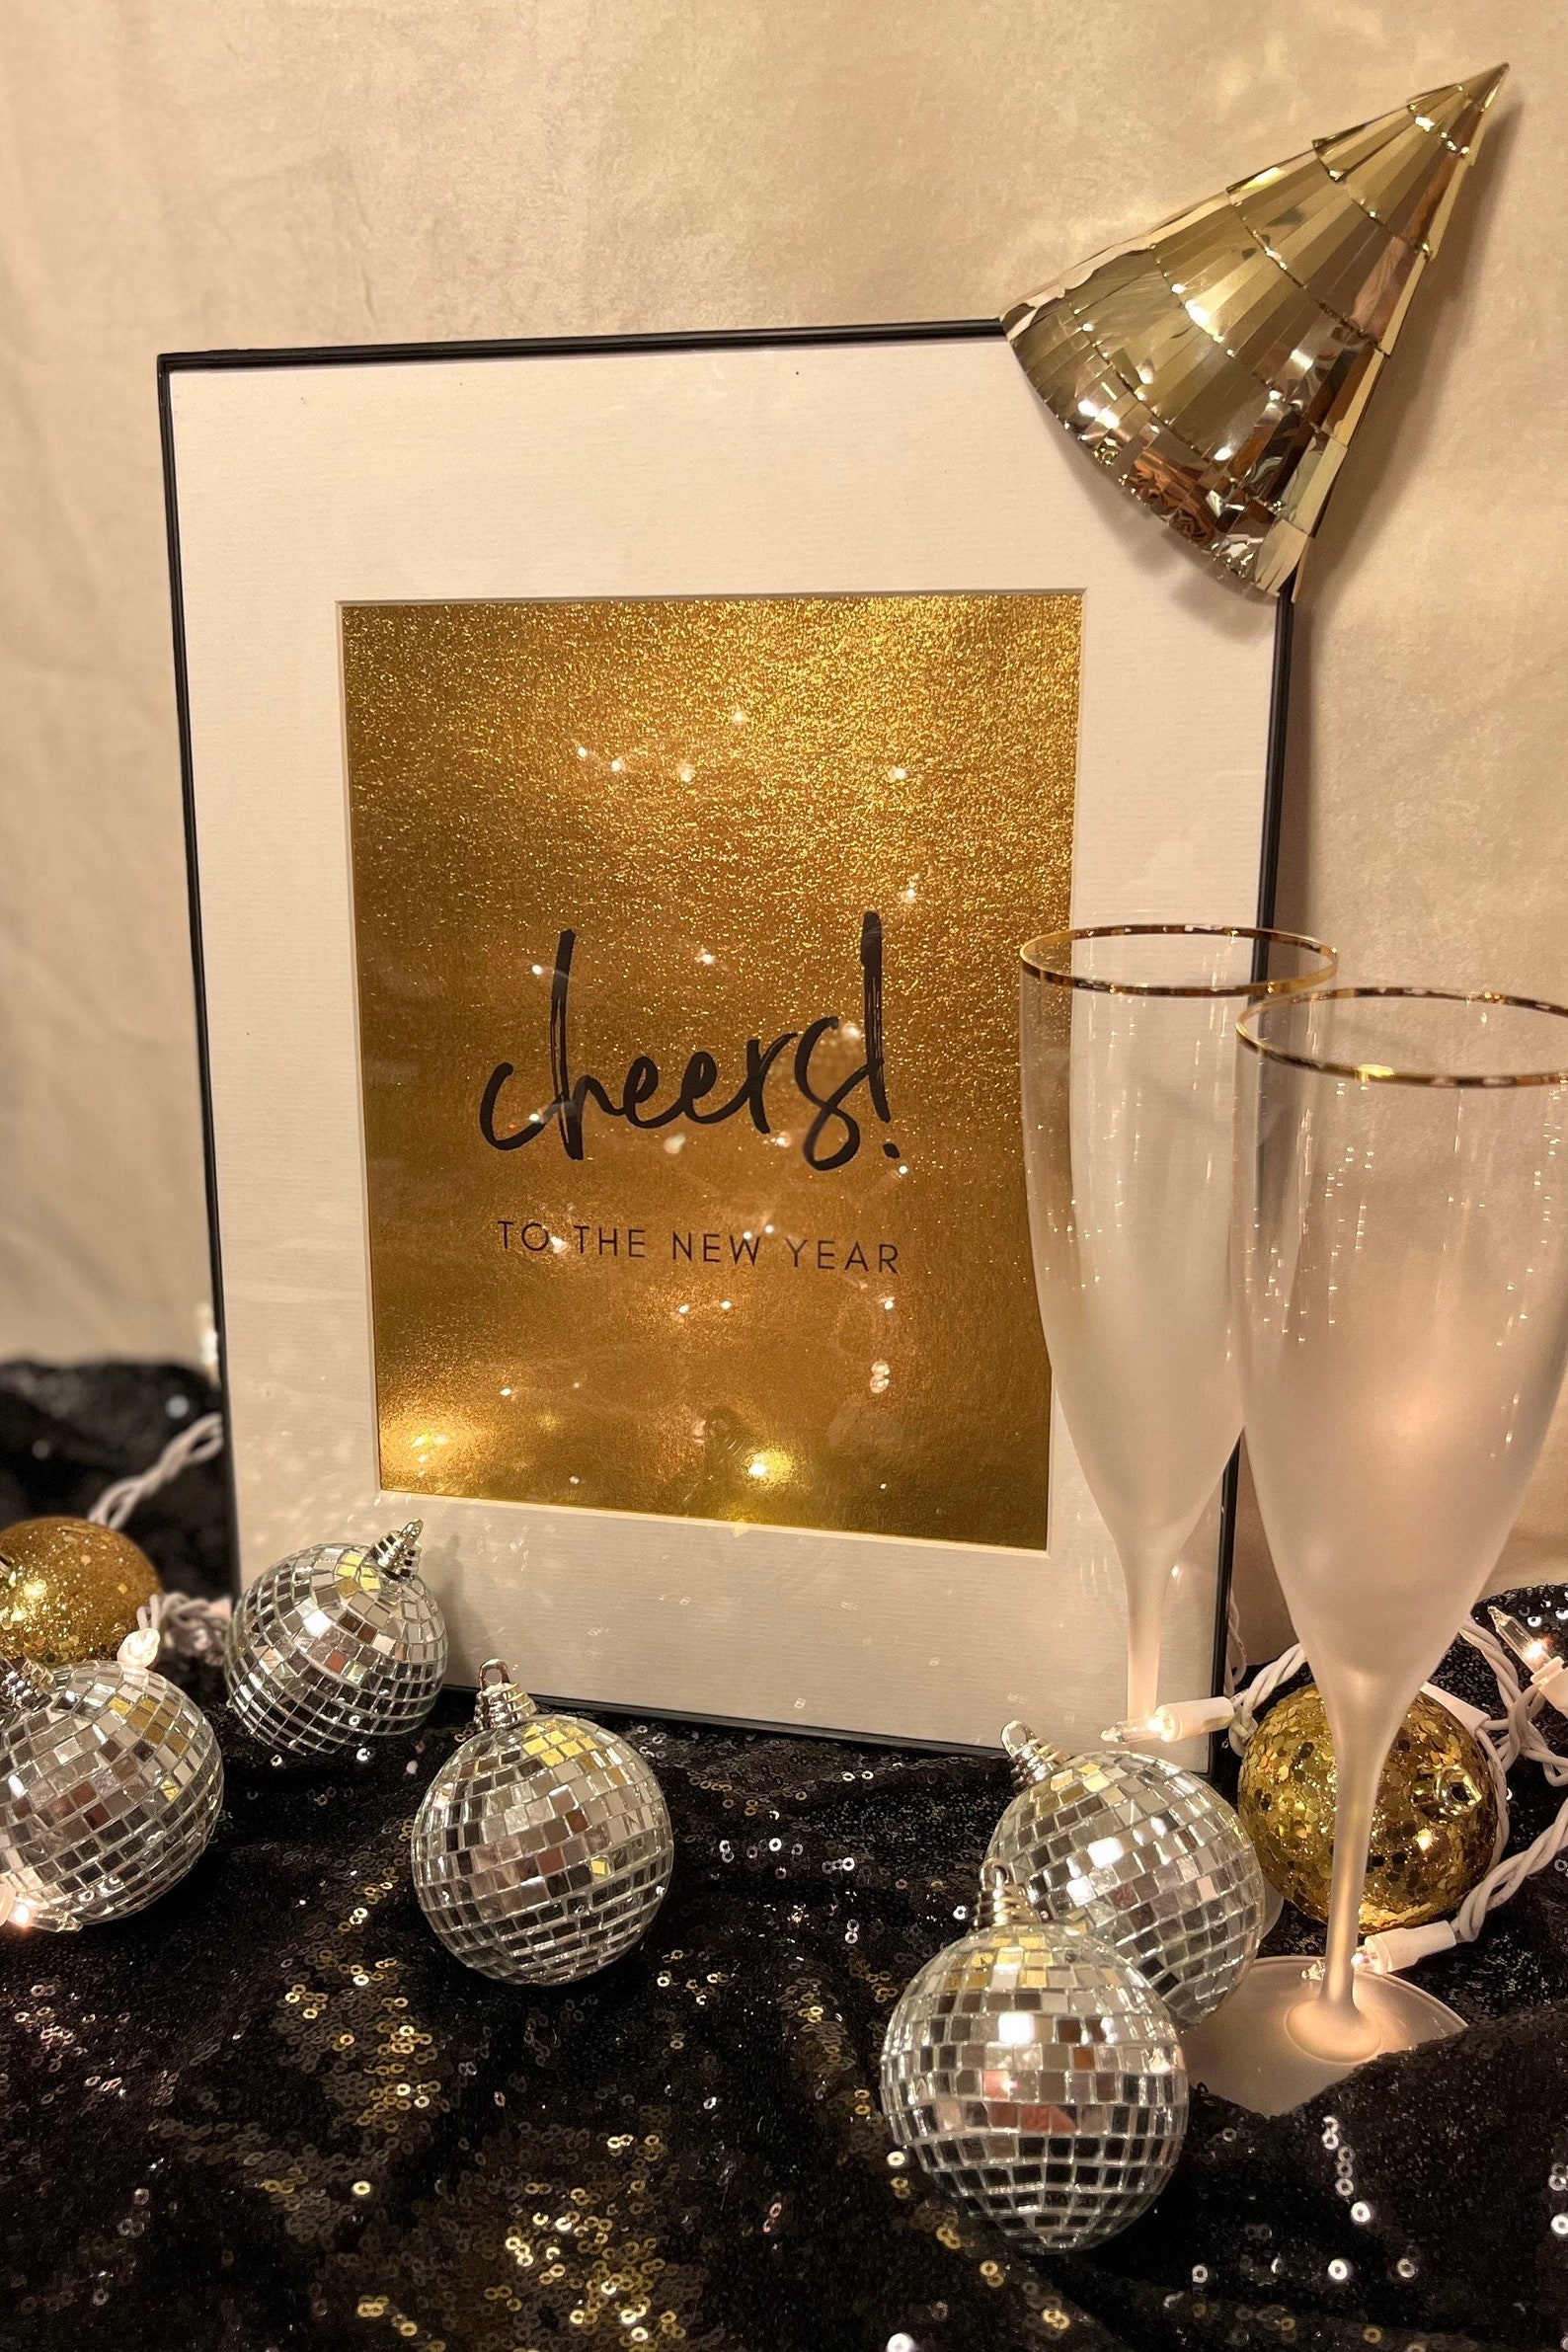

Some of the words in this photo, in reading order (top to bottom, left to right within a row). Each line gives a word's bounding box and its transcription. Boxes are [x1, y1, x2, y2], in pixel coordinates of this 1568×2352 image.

[480, 910, 900, 1171] cheers!
[498, 1220, 549, 1252] TO
[573, 1224, 646, 1258] THE
[672, 1230, 760, 1266] NEW
[785, 1238, 900, 1274] YEAR
